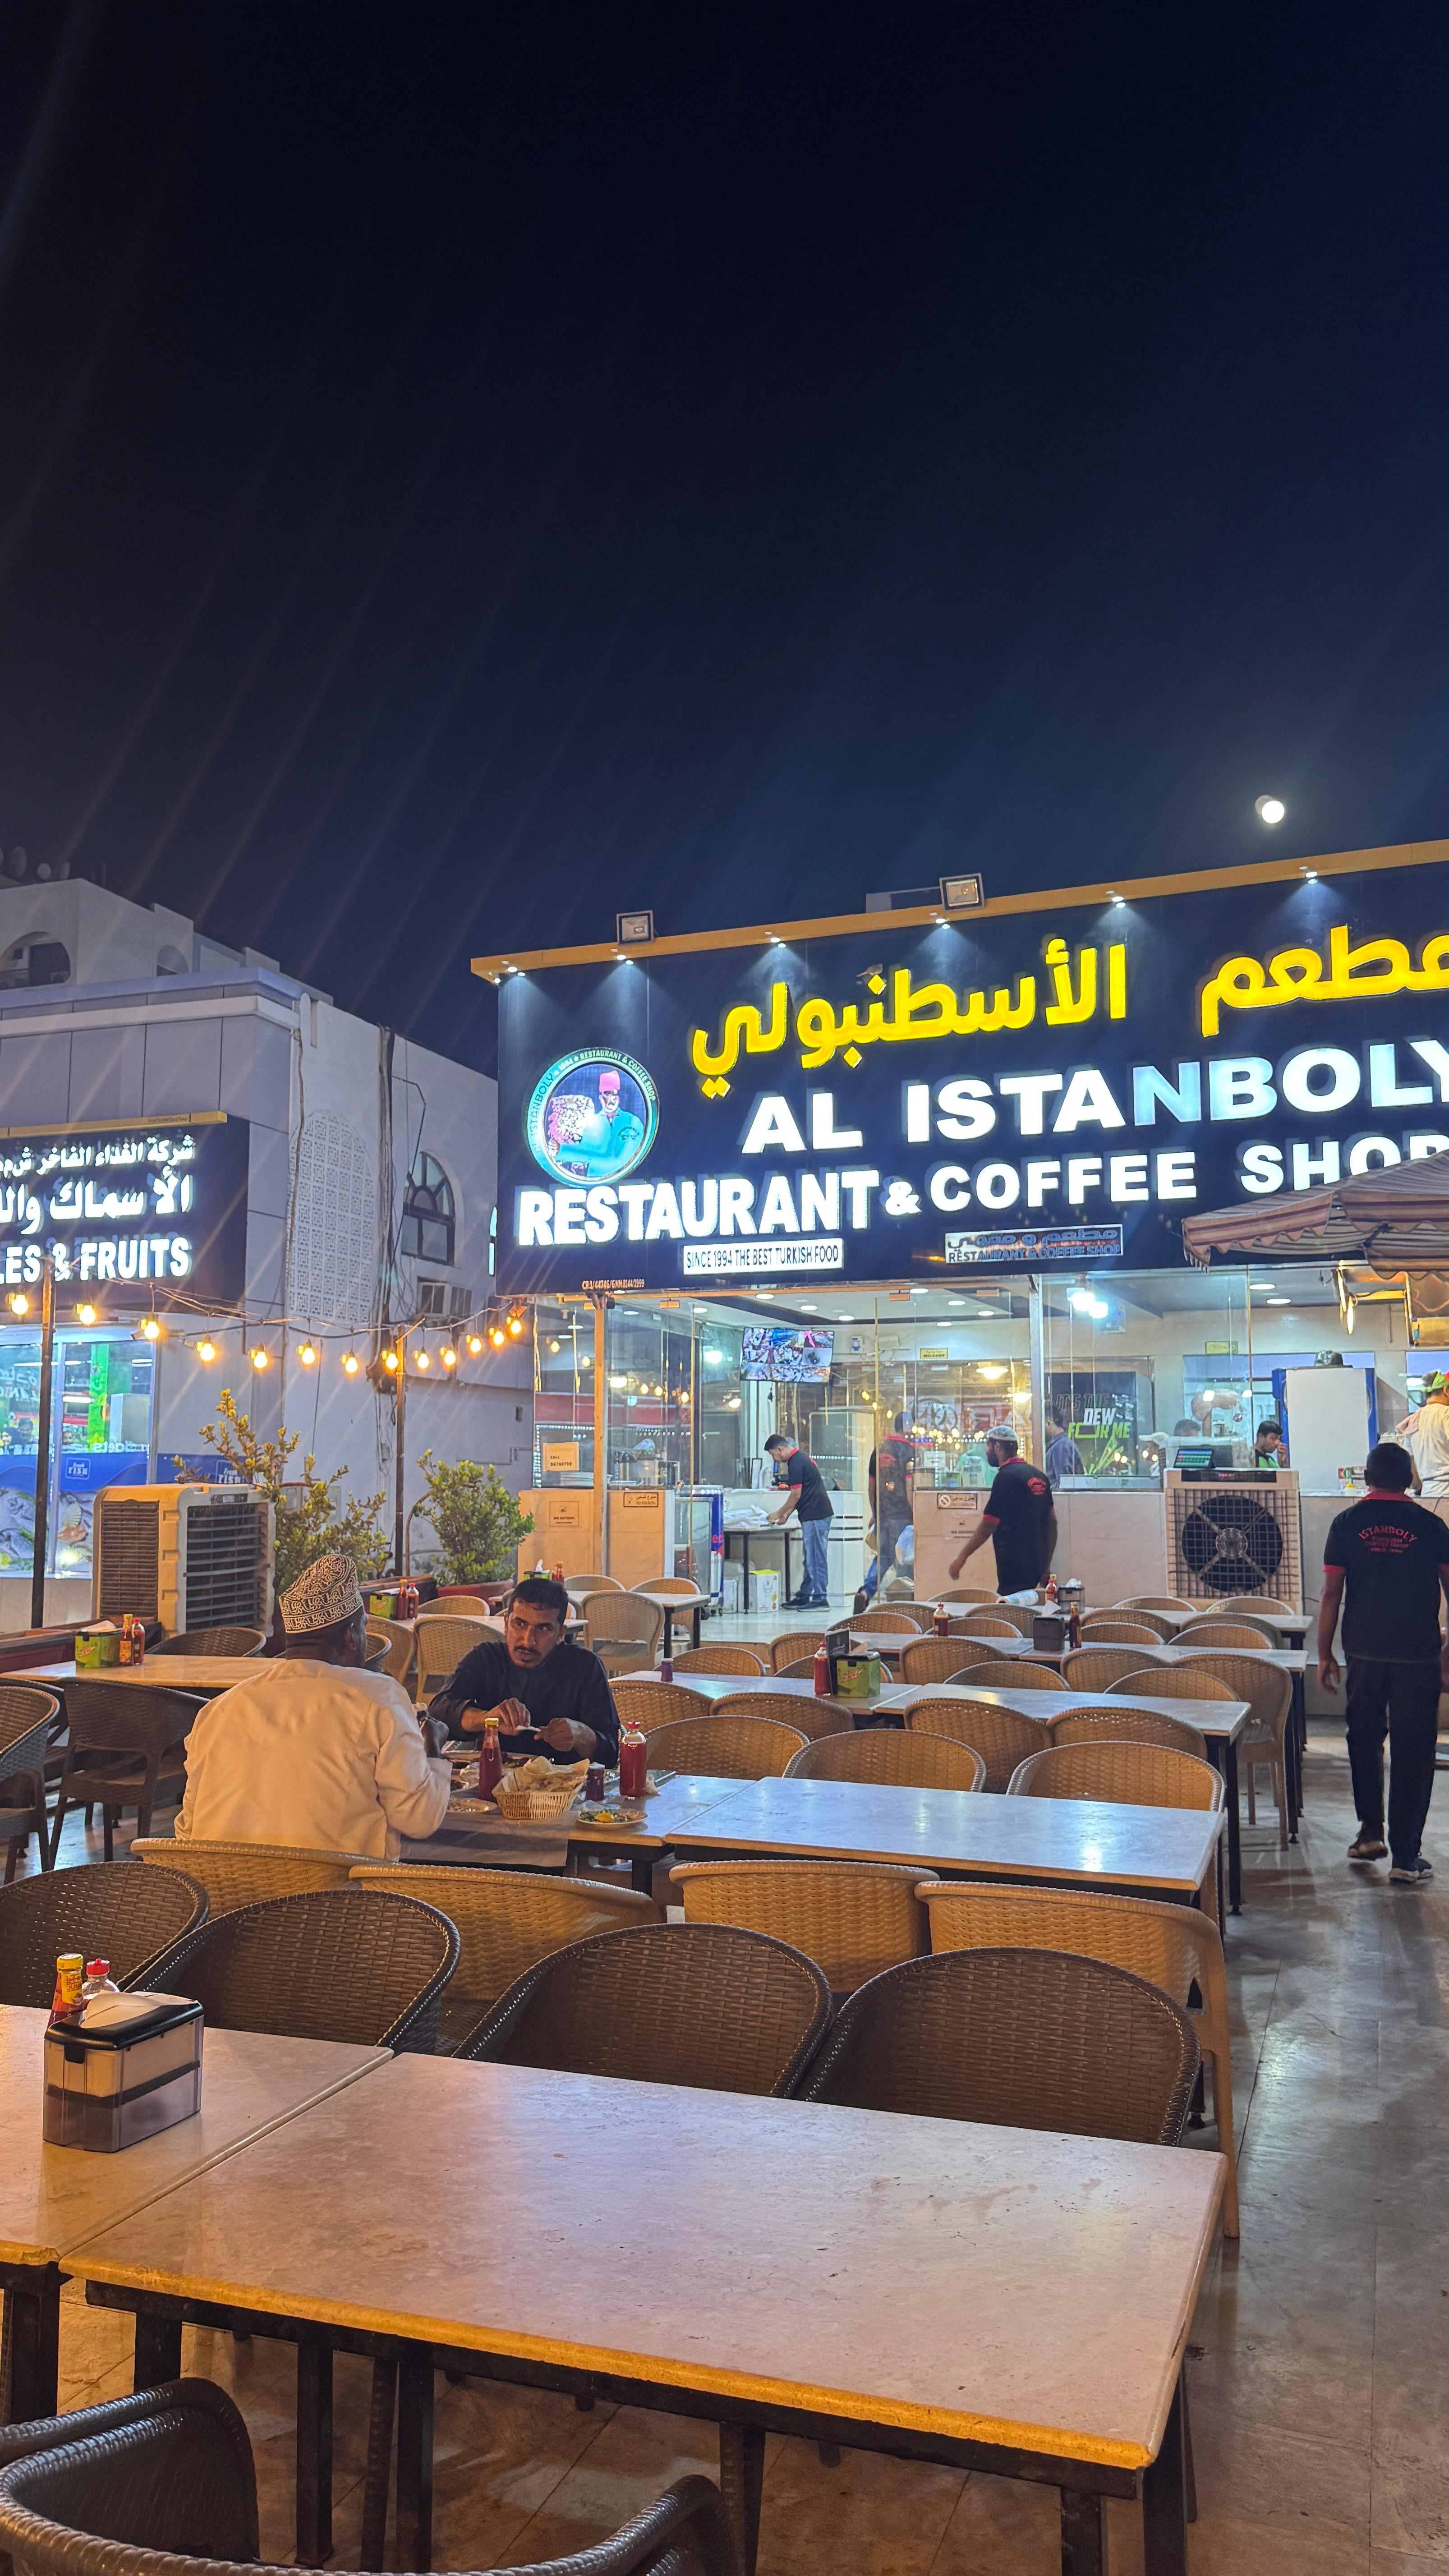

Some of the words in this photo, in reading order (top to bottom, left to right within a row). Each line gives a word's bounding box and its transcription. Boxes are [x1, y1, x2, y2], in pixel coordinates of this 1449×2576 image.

[692, 939, 1126, 1099] الأسطنبولي
[580, 1050, 622, 1060] RESTAURANT
[628, 1060, 648, 1082] COFFEE
[645, 1080, 656, 1101] SHOP
[742, 1092, 863, 1154] AL
[36, 1146, 91, 1175] الفاخر
[95, 1142, 143, 1167] الغذاء
[147, 1135, 193, 1166] شركة
[519, 1170, 879, 1246] RESTAURANT
[885, 1181, 922, 1215] &
[930, 1151, 1196, 1212] COFFEE
[1022, 1234, 1036, 1246] و
[1042, 1228, 1118, 1246] مطعم
[0, 1244, 41, 1284] ES
[52, 1242, 70, 1281] &
[80, 1237, 189, 1280] FRUITS
[687, 1251, 711, 1268] SINCE
[714, 1250, 731, 1267] 1994
[736, 1249, 750, 1266] THE
[753, 1248, 772, 1265] BEST
[776, 1247, 812, 1264] TURKISH
[815, 1245, 838, 1263] FOOD
[948, 1248, 1026, 1262] RESTAURANT
[1038, 1246, 1083, 1258] COFFEE
[1086, 1244, 1120, 1255] SHOP
[1083, 1408, 1116, 1425] DEW
[1112, 1422, 1131, 1438] ME
[1358, 1525, 1417, 1542] ISTANBOLY
